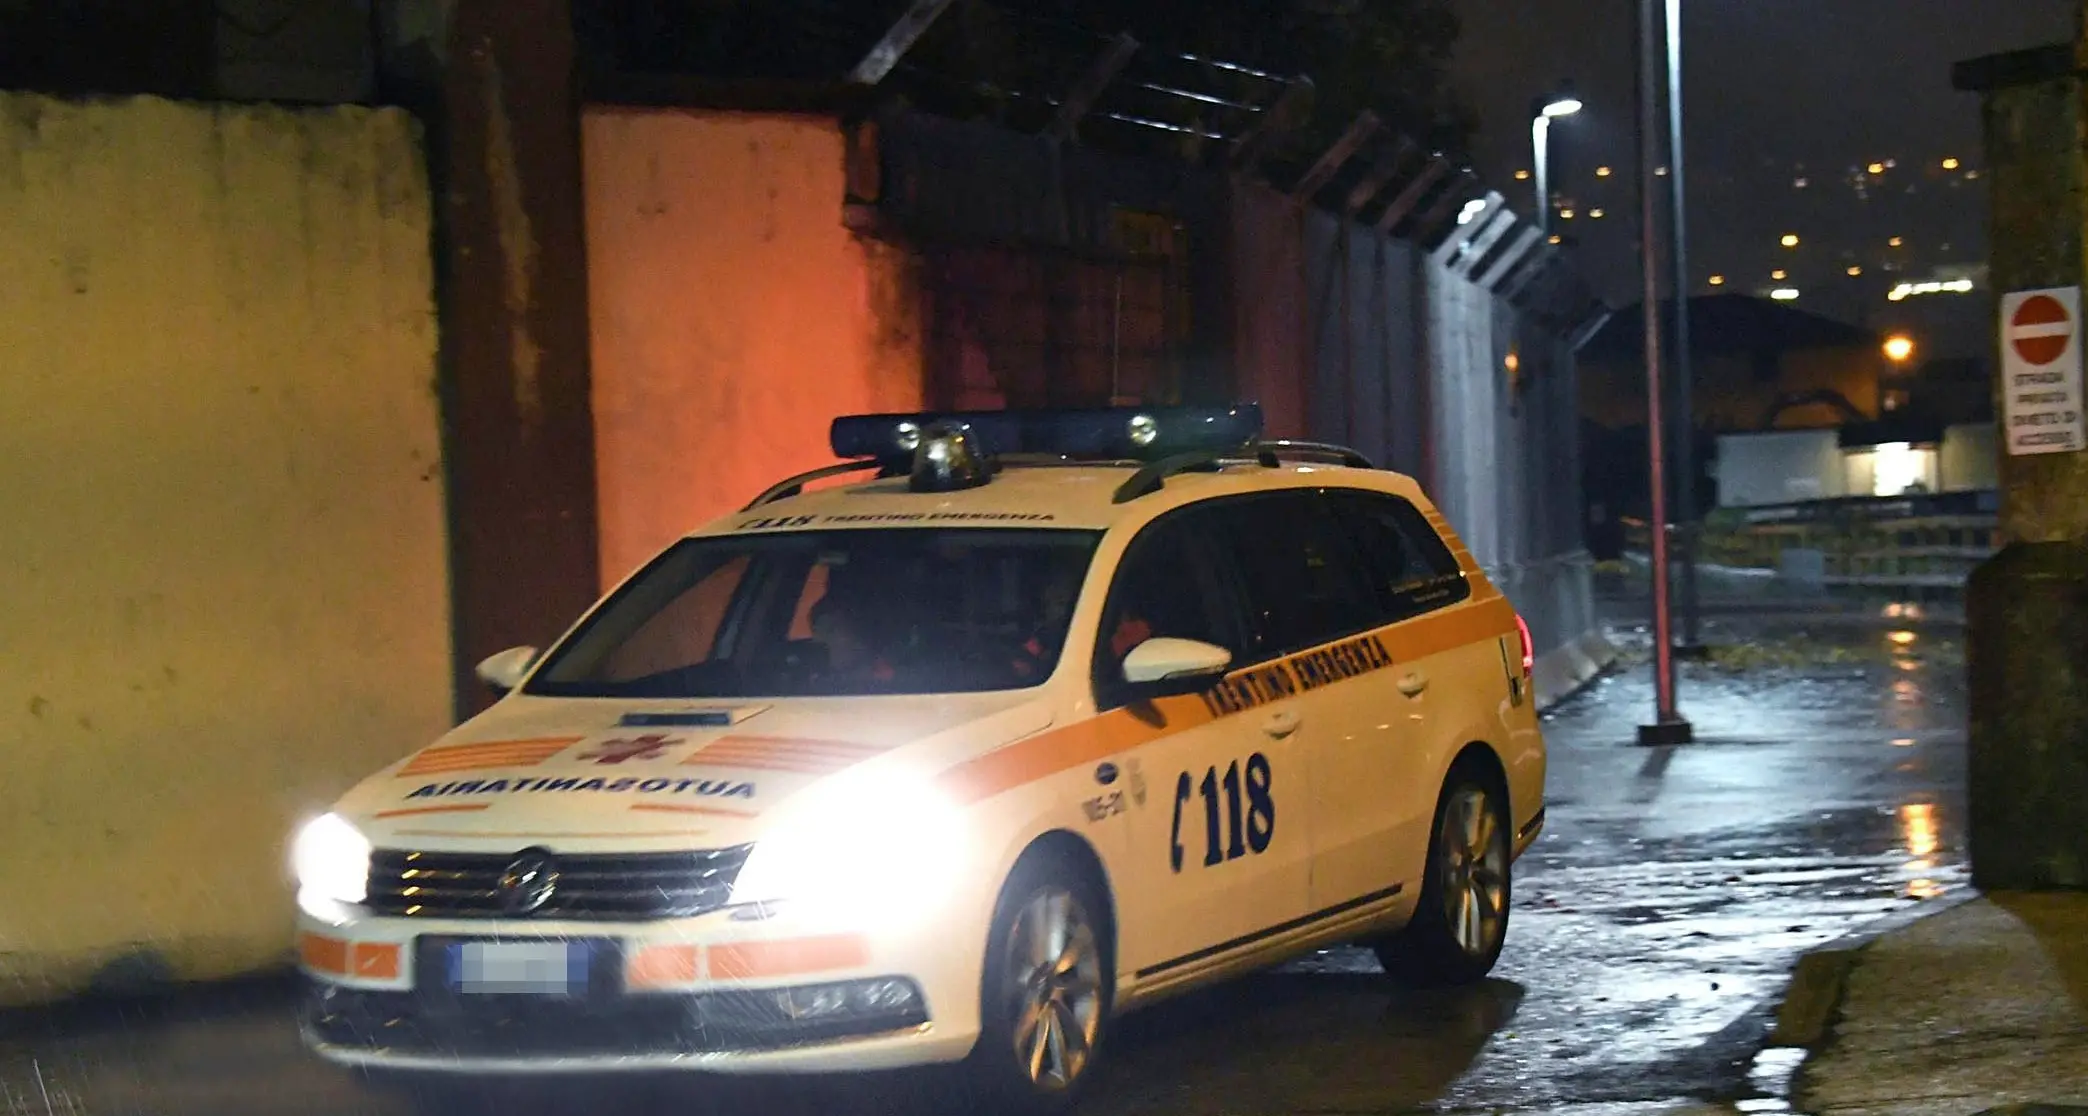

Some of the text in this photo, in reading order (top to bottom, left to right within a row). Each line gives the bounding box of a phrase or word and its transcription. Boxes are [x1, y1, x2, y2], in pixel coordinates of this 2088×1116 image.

[824, 514, 924, 523] TRENTINO
[927, 513, 1055, 521] EMERGENZA
[1202, 635, 1394, 719] TRENTINO EMERGENZA
[1200, 752, 1275, 868] 118
